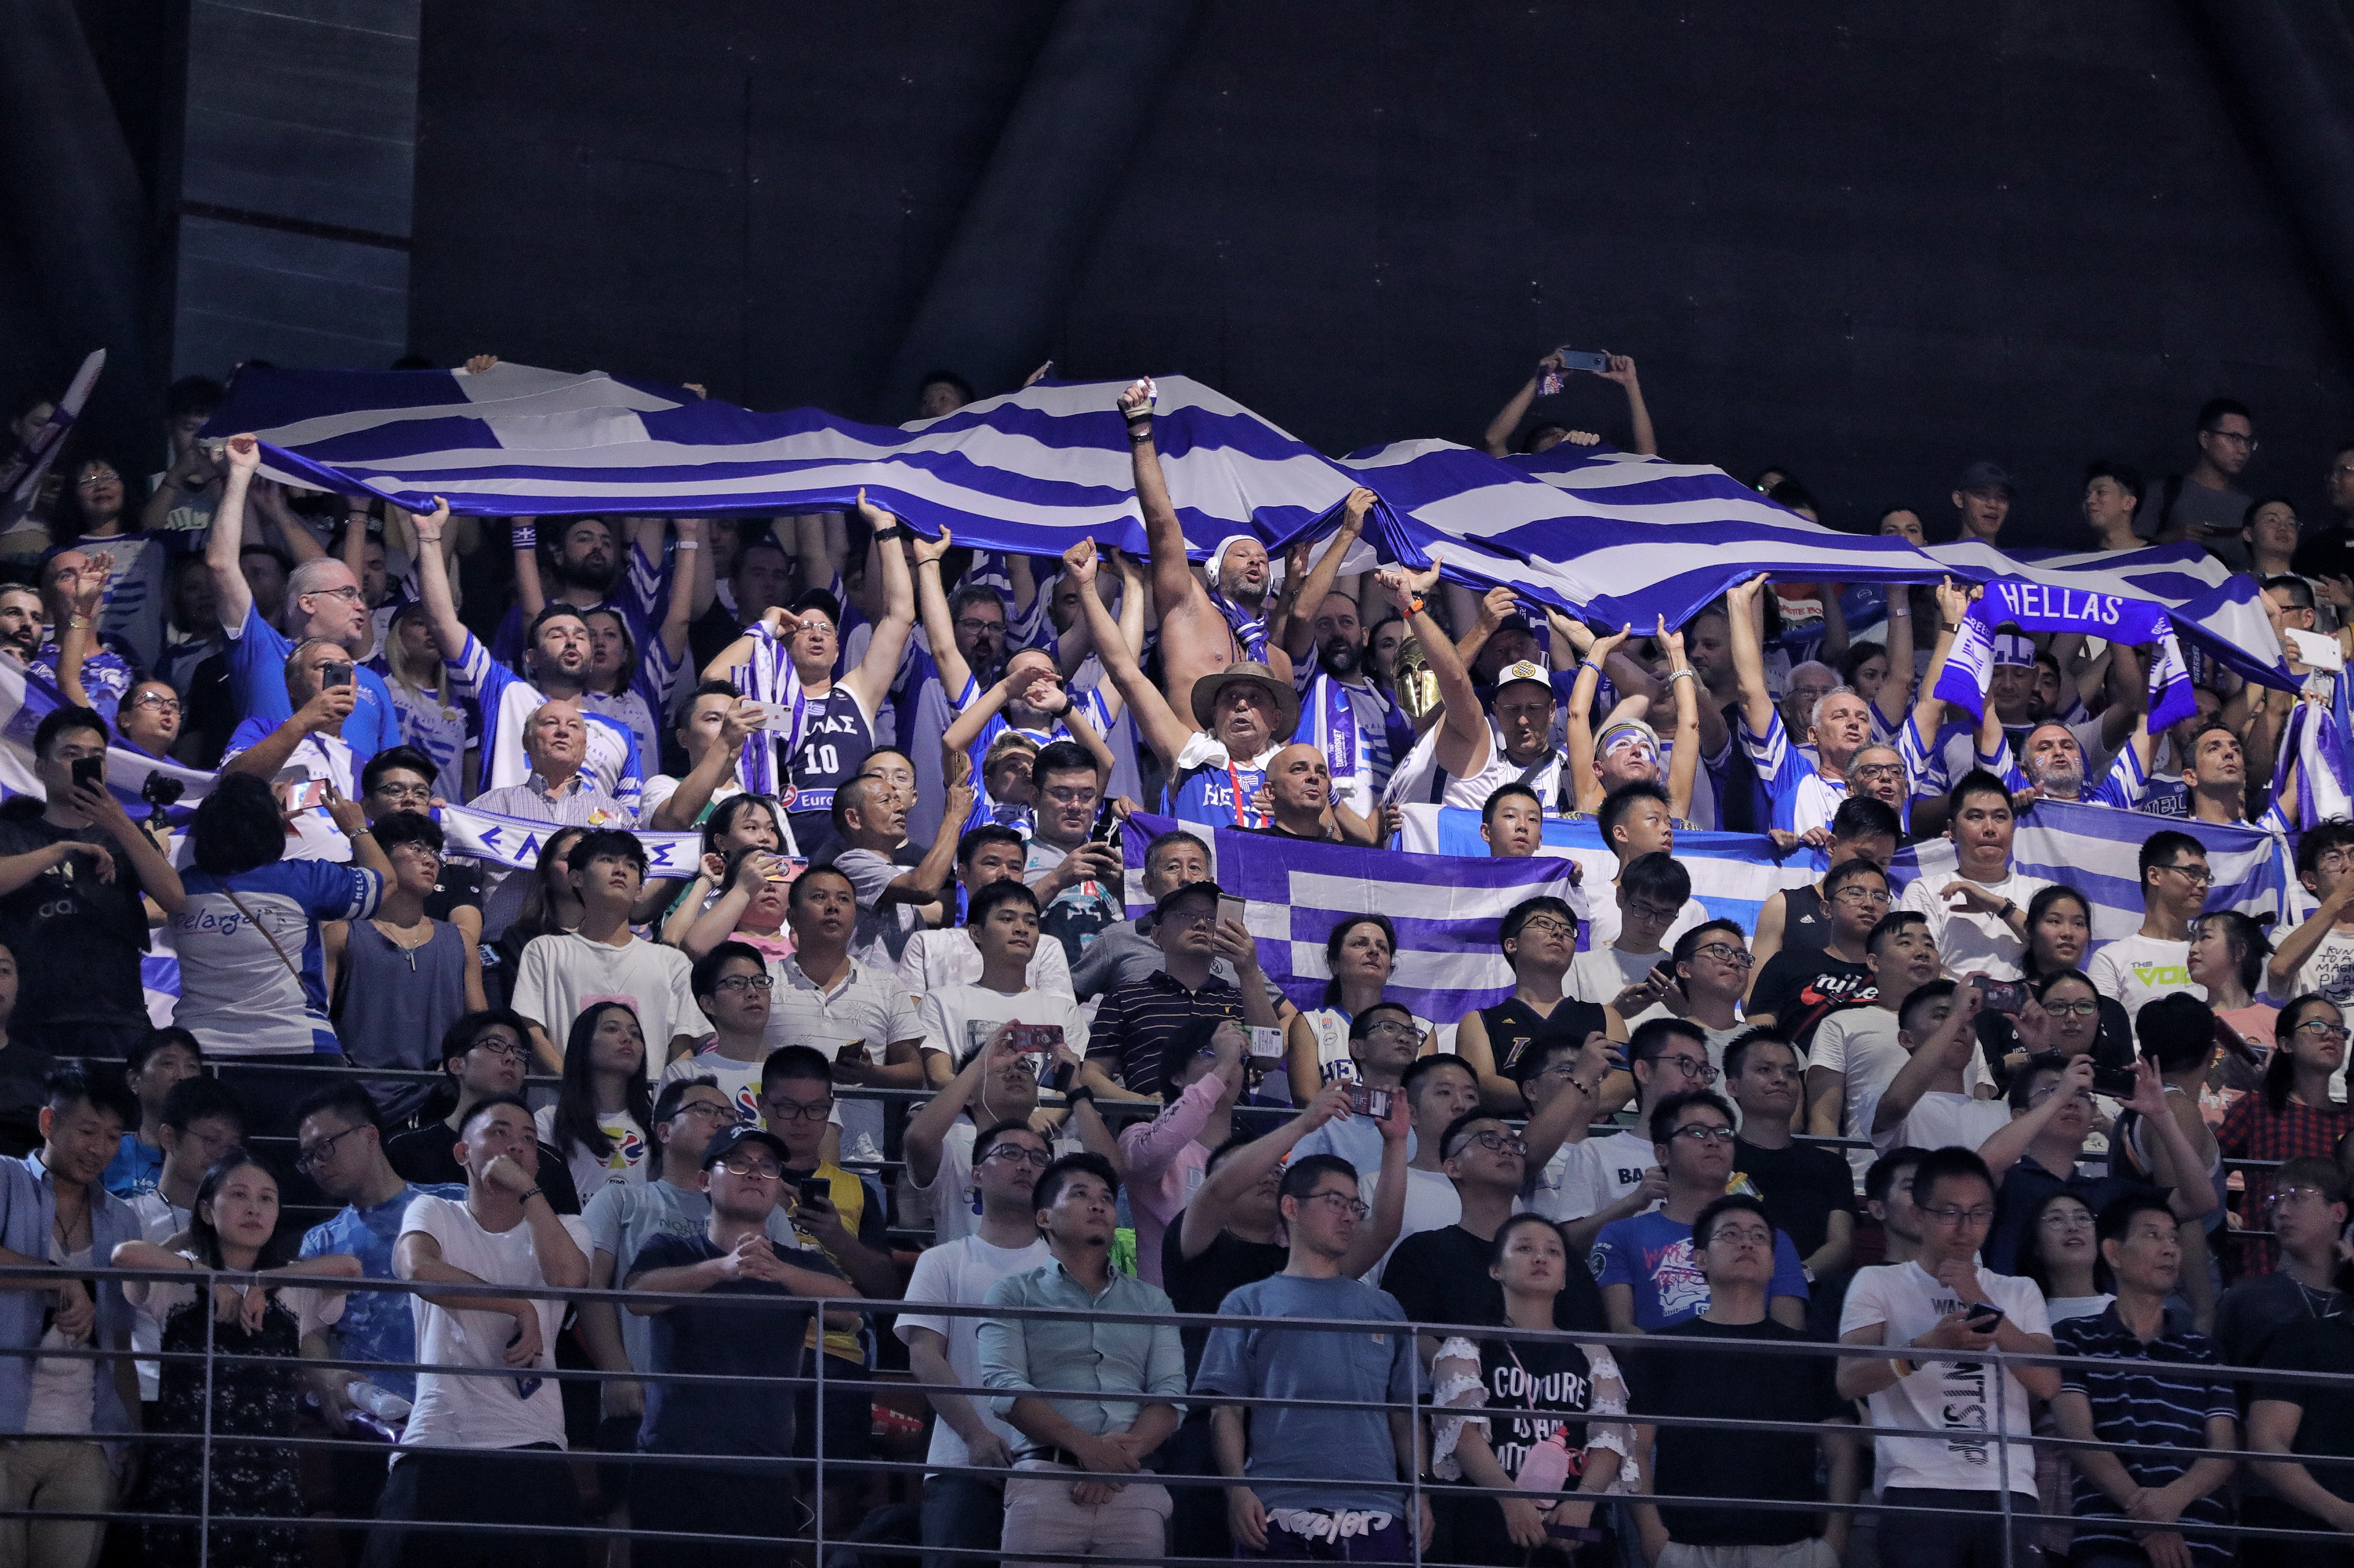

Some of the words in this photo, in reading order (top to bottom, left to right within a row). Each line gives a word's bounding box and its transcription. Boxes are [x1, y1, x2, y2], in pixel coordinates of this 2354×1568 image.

[1998, 583, 2123, 626] HELLAS
[805, 743, 840, 774] 10
[801, 794, 834, 807] Euro
